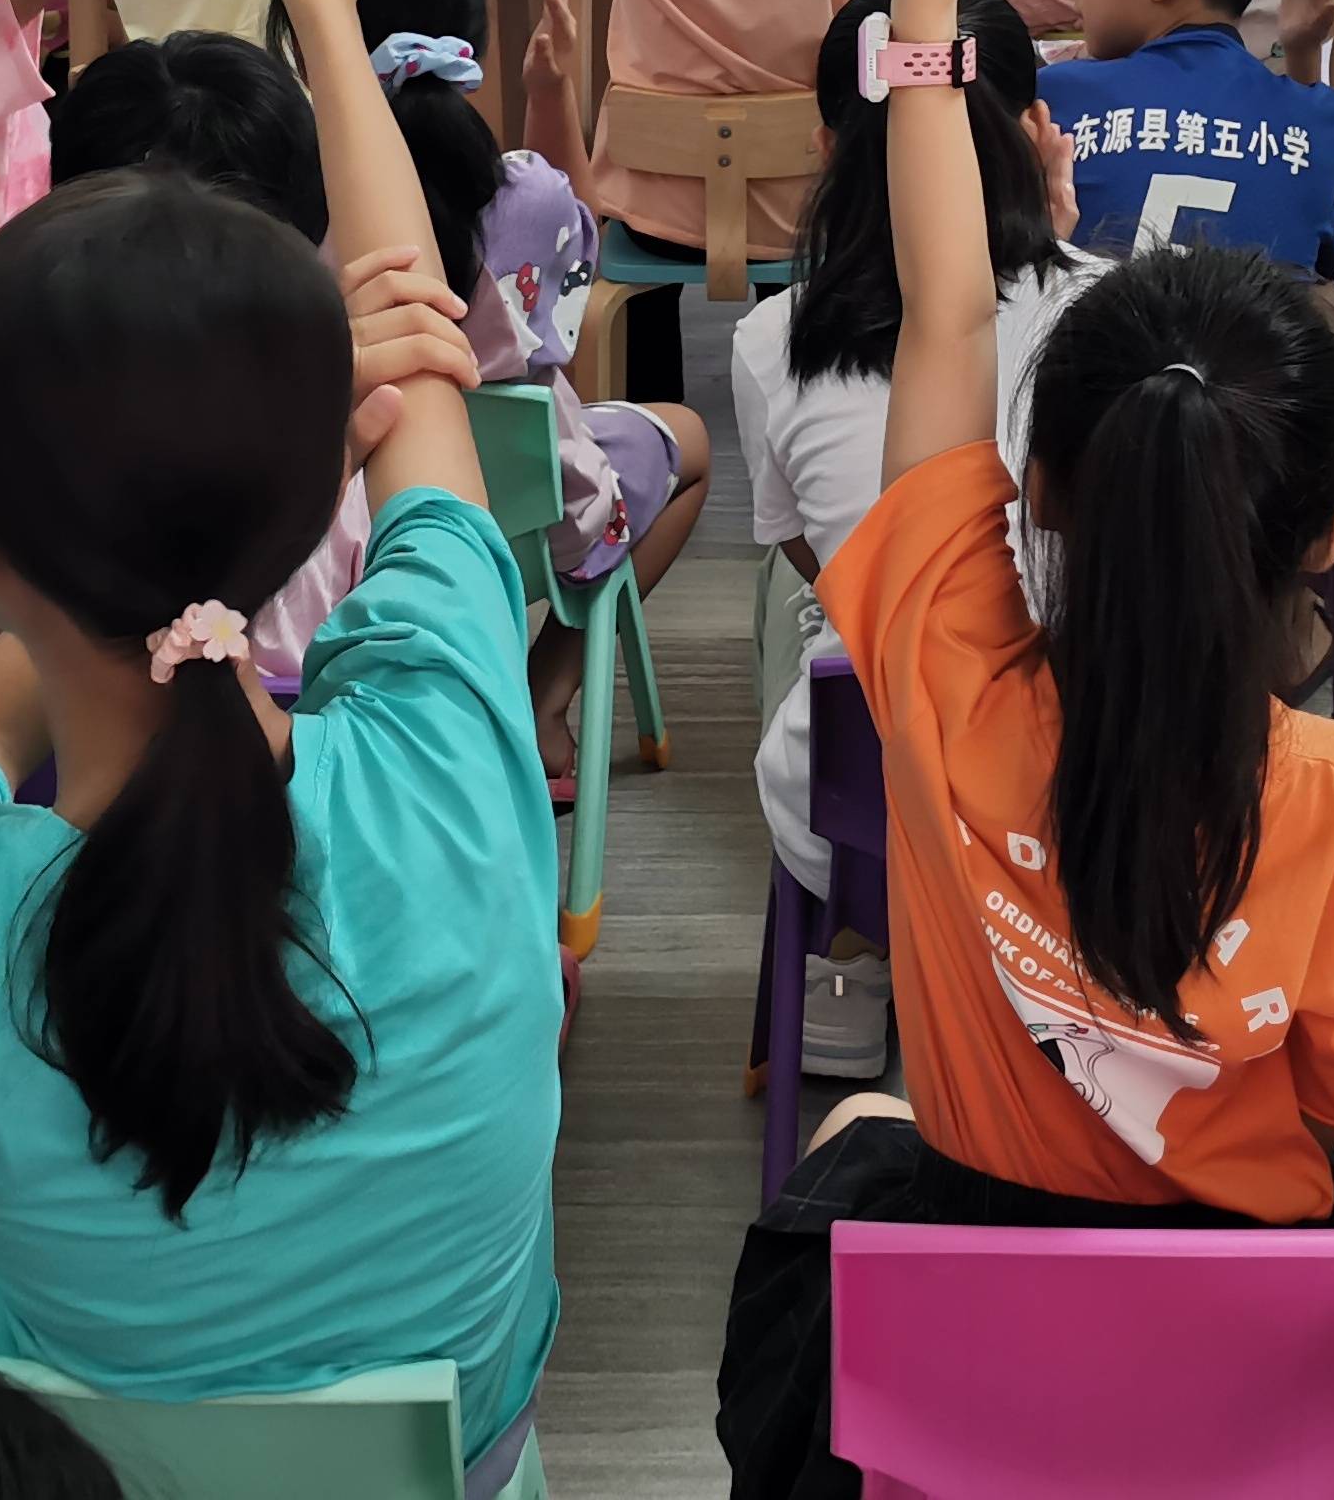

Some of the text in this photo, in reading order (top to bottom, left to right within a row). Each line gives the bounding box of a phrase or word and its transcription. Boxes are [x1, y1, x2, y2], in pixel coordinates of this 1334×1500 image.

[1072, 108, 1311, 174] 东源县第五小学
[985, 890, 1092, 983] ORDINA
